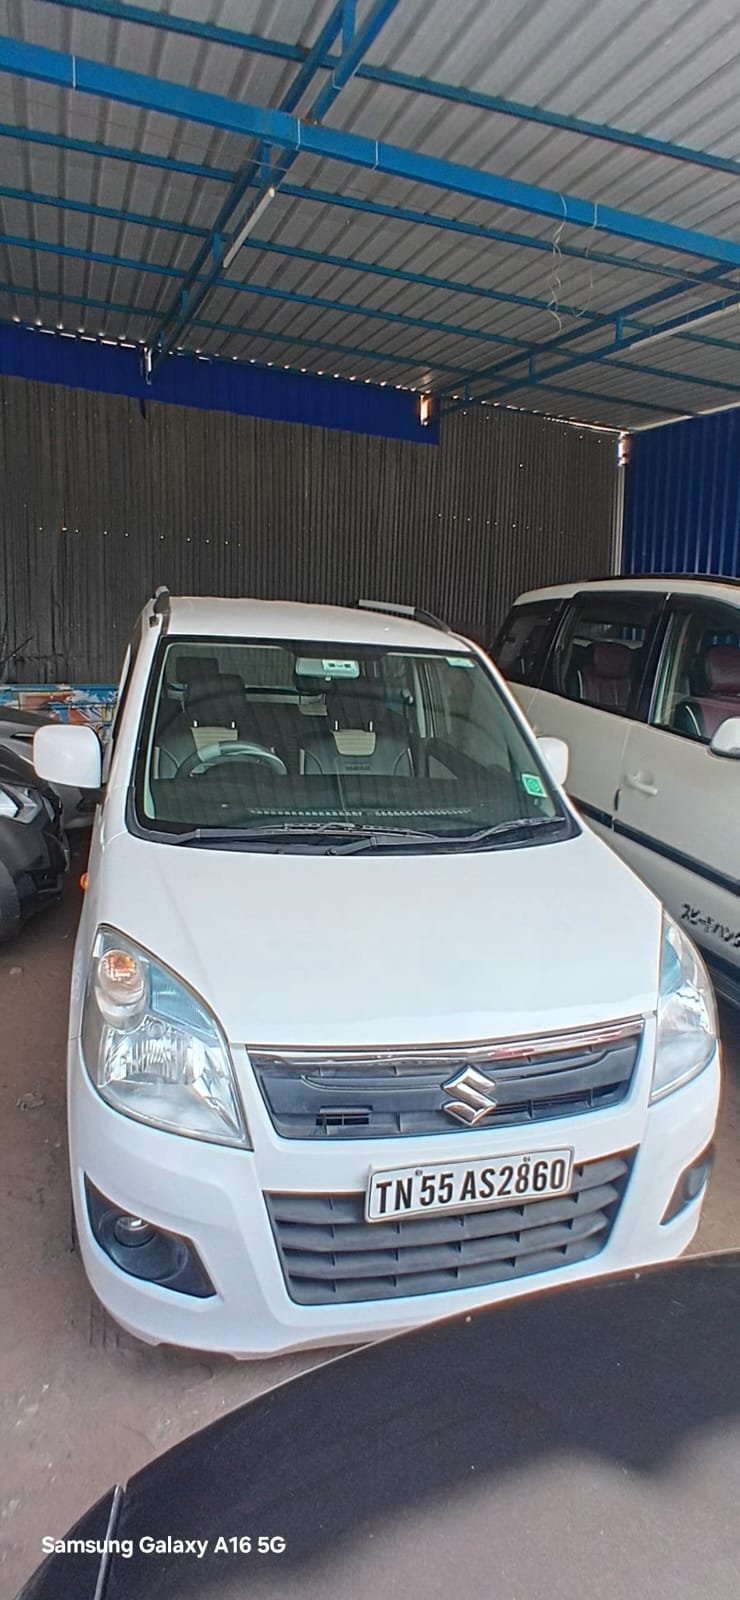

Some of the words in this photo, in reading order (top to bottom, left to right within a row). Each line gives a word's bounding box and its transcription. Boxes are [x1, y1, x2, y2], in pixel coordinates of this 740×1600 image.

[376, 1177, 413, 1214] TN
[419, 1173, 454, 1207] 55
[459, 1159, 566, 1201] AS2860
